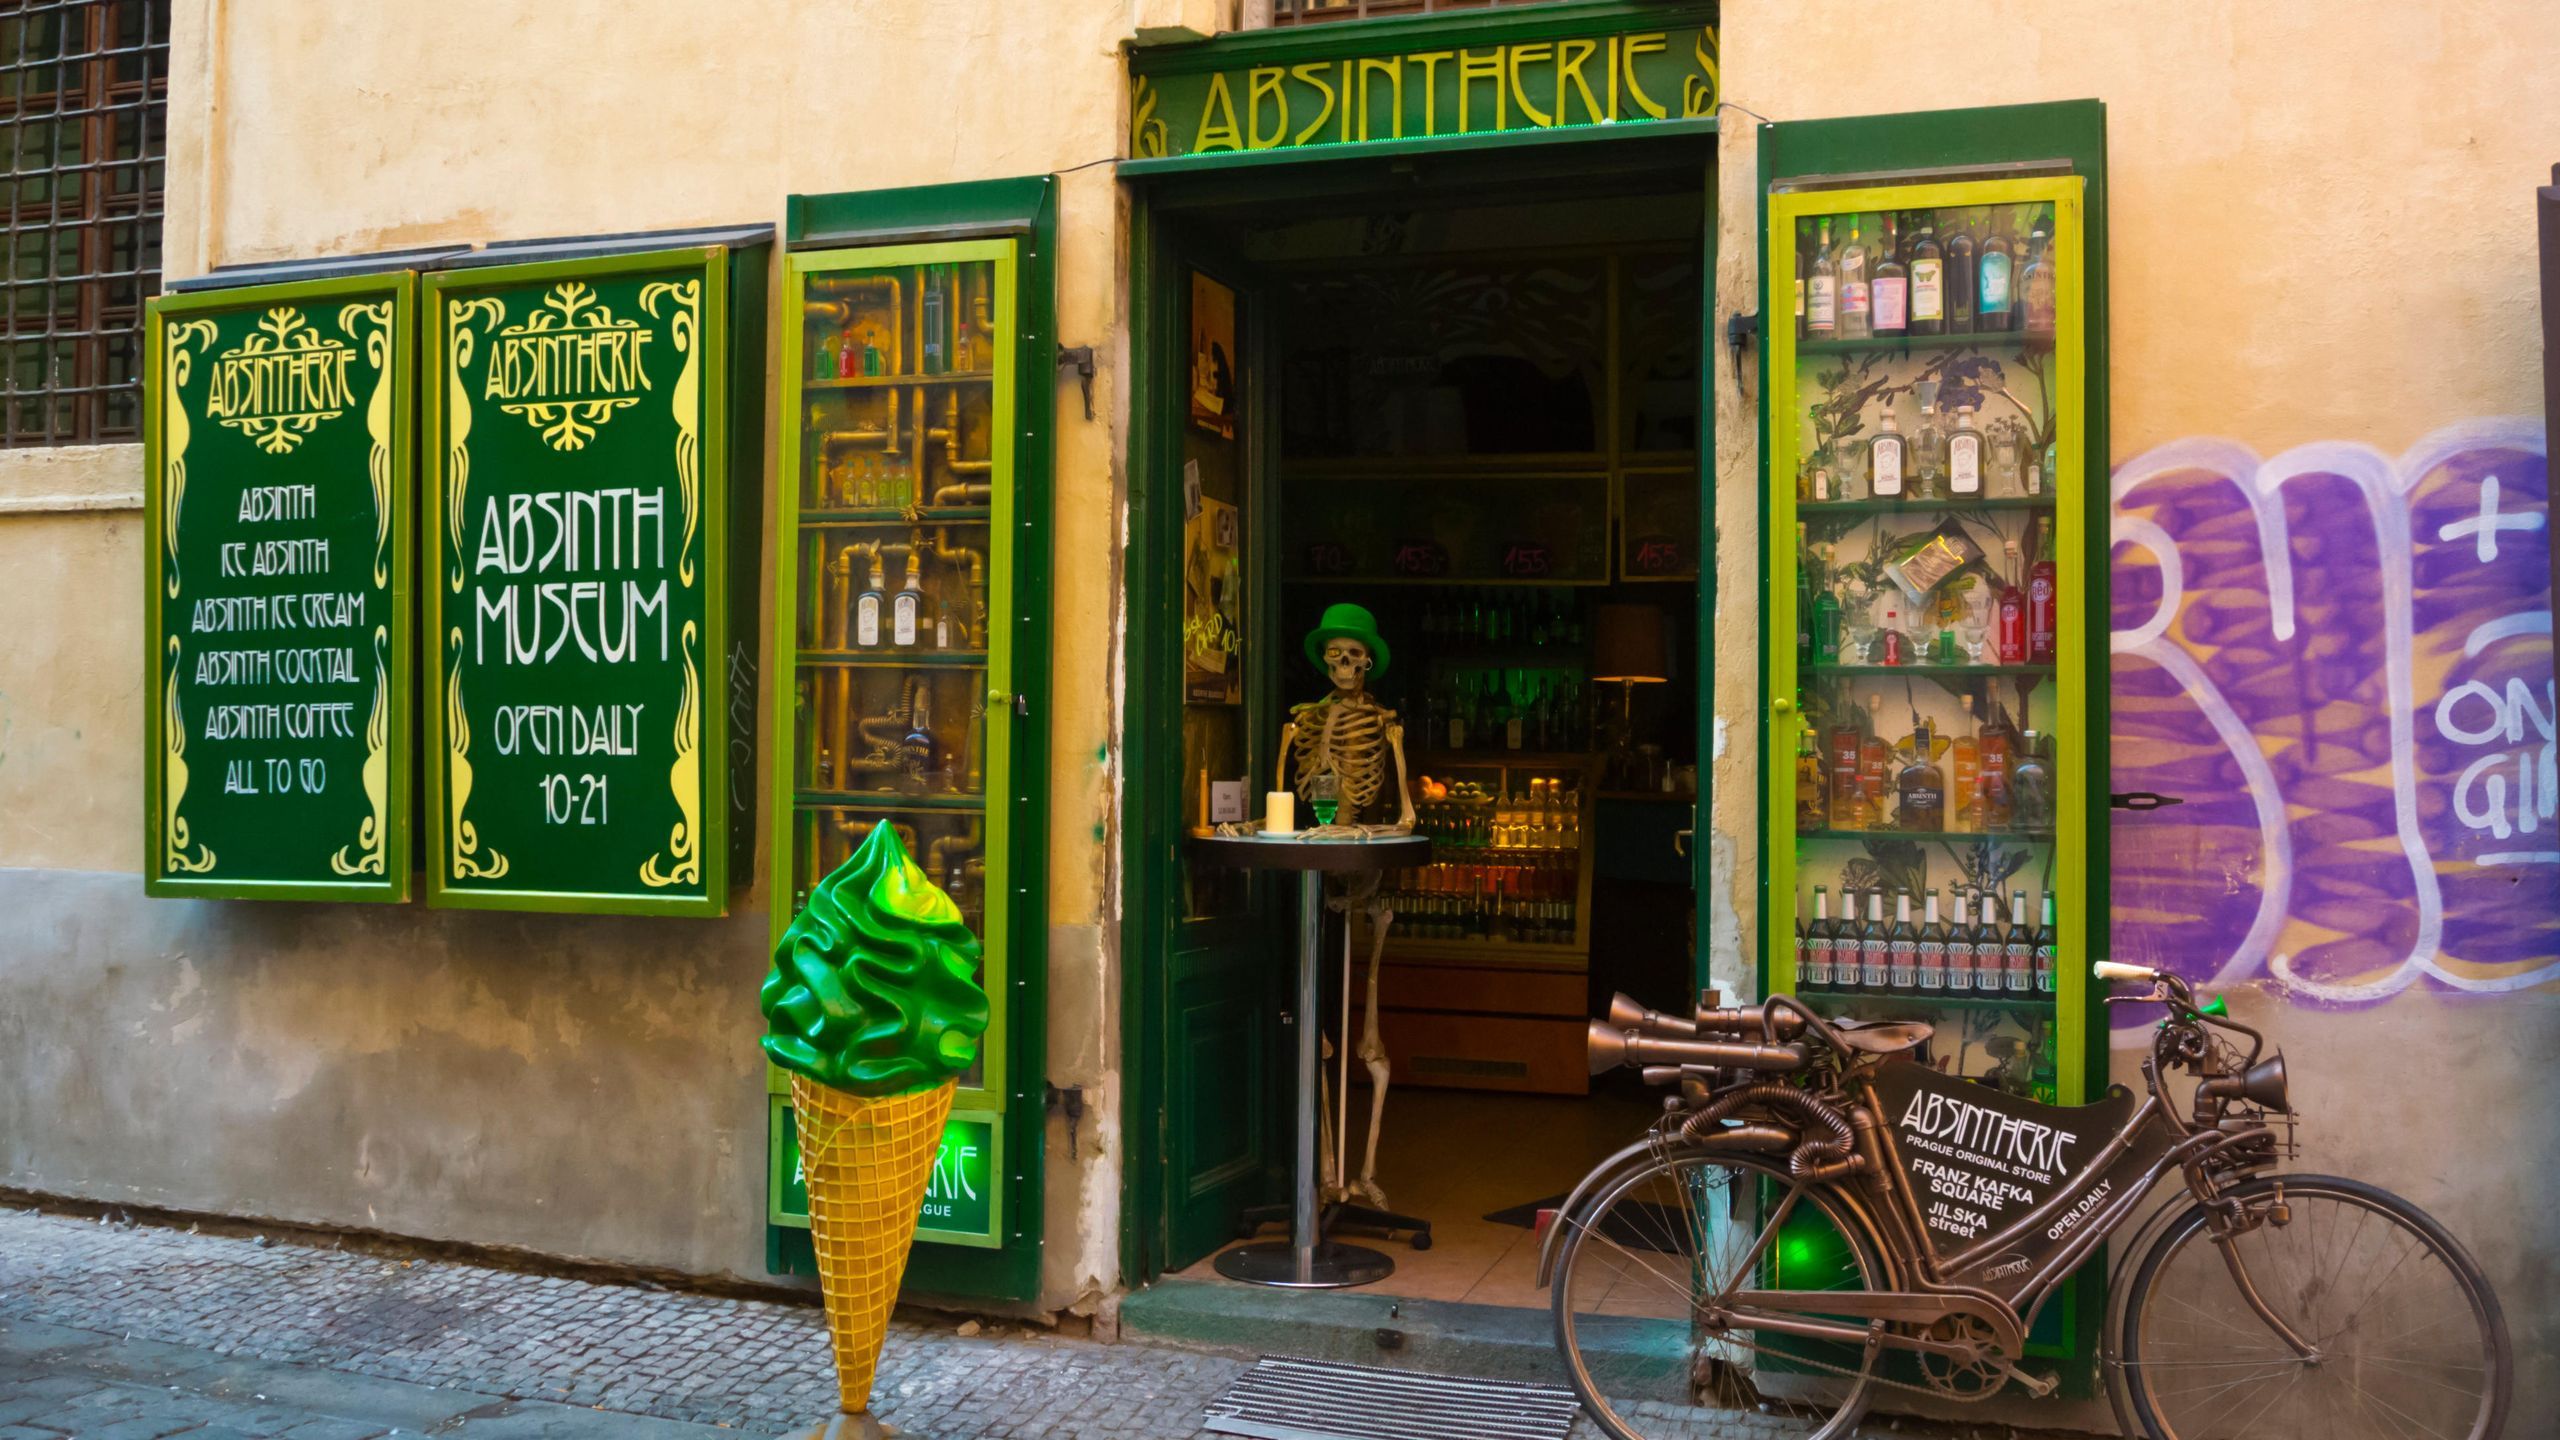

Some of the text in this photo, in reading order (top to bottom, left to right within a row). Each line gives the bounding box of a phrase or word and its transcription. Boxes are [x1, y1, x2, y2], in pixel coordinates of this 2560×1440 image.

[1194, 33, 1667, 156] ABSINTHERIE
[207, 348, 356, 418] ABSINTHERIE
[485, 329, 652, 401] ABSINTHERIE
[238, 484, 316, 523] ABSINTH
[475, 486, 664, 575] ABSINTH
[221, 538, 329, 577] ICE ABSINTH
[191, 591, 365, 634] ABSINTH ICE CREAM
[476, 579, 669, 667] MUSEUM
[195, 647, 360, 686] ABSINTH COCKTAIL
[204, 702, 355, 741] ABSINTH COFFEE
[494, 702, 645, 756] OPEN DAILY
[223, 758, 326, 794] ALL TO GO
[1842, 750, 1856, 760] 35
[1989, 753, 2003, 763] 35
[538, 773, 608, 825] 10-21
[1901, 1090, 2077, 1176] ABSINTHERIE
[1906, 1134, 2052, 1185] PRAGUE ORIGINAL STORE
[1911, 1158, 2034, 1205] FRANZ KAFKA
[1928, 1201, 1989, 1230] JILSKA
[1929, 1179, 2004, 1211] SQUARE
[2047, 1208, 2081, 1241] OPEN
[2078, 1178, 2113, 1212] DAILY
[1928, 1216, 1976, 1239] street
